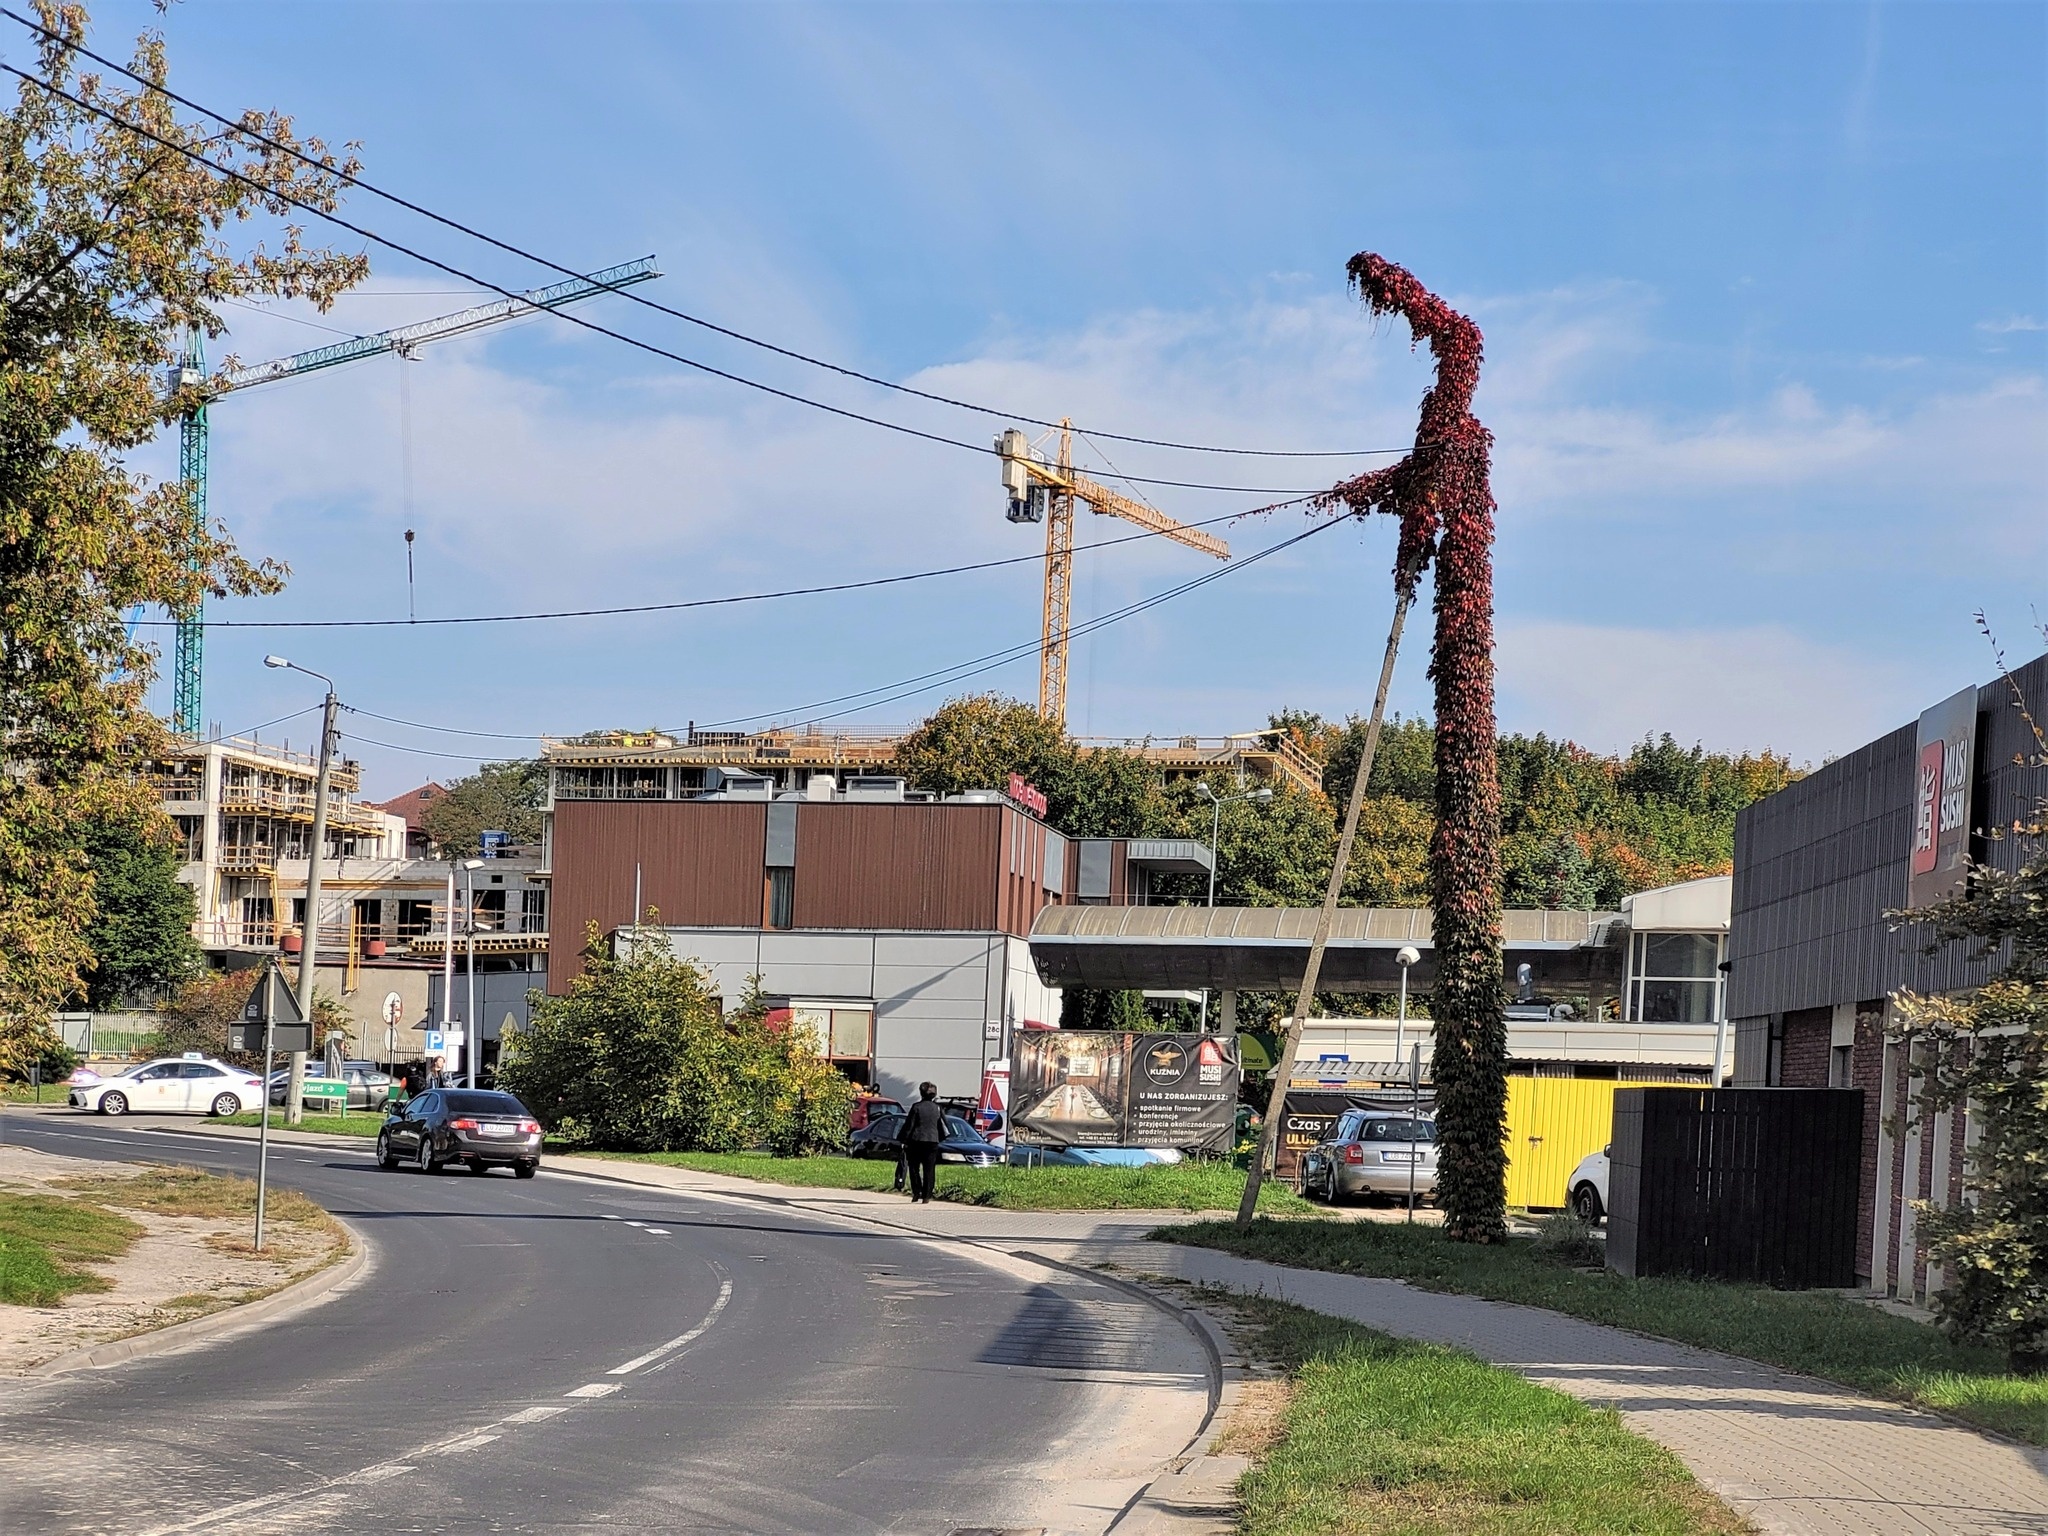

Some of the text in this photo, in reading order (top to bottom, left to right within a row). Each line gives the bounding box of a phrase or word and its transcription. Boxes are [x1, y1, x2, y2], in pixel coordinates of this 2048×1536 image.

[1942, 739, 1968, 792] MUSI
[1940, 789, 1965, 834] SUSHI
[430, 1032, 443, 1049] P
[1200, 1065, 1222, 1074] MUSI
[1199, 1074, 1222, 1082] SUSHI
[1140, 1105, 1173, 1113] spotkanie
[1287, 1117, 1321, 1131] Czas
